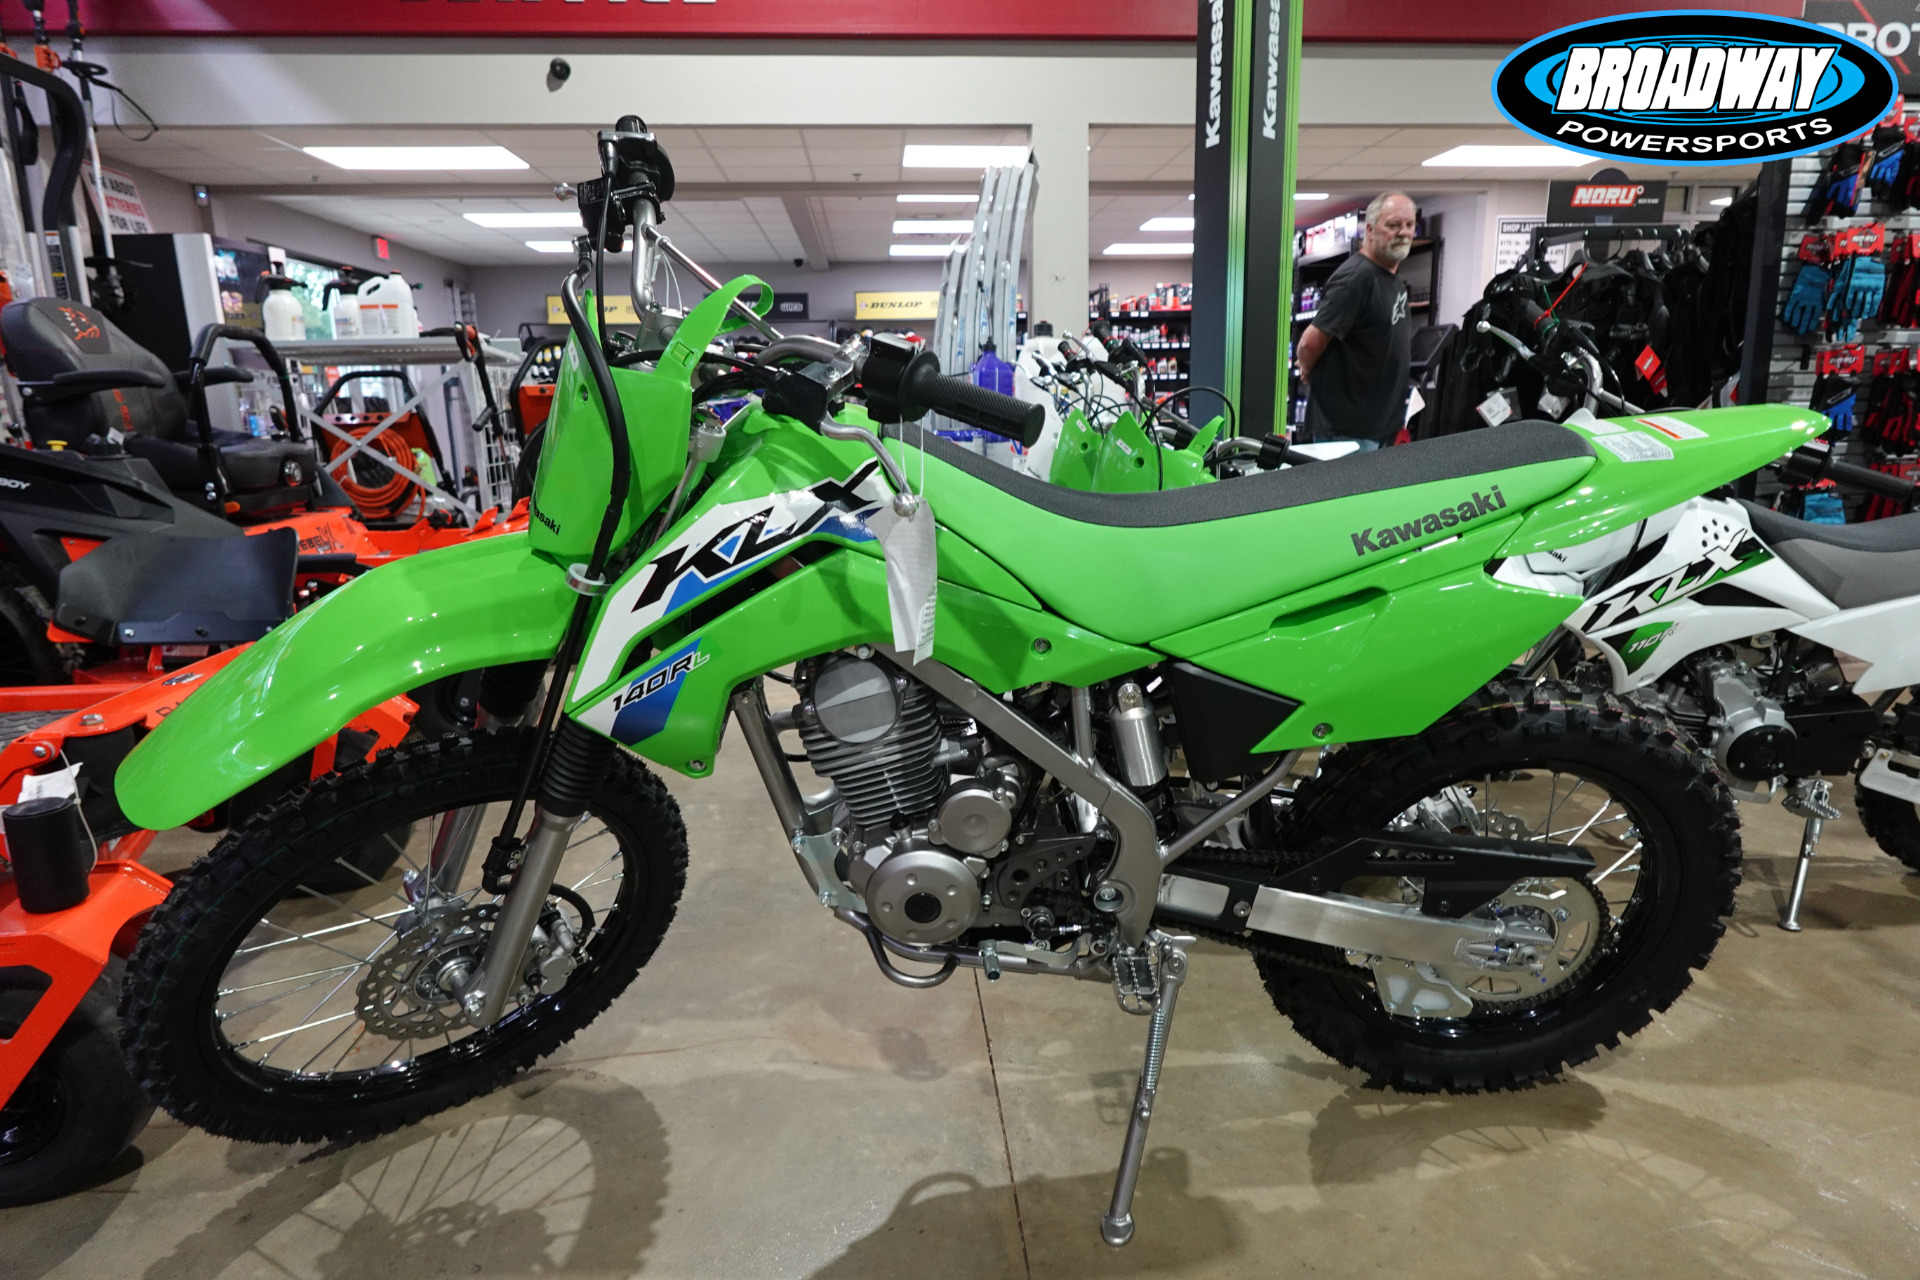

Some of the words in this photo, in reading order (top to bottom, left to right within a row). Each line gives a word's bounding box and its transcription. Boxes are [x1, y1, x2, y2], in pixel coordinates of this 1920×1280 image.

[1205, 0, 1224, 149] Kawasa
[1573, 186, 1638, 205] NORU
[104, 195, 146, 218] ATTERIES
[1502, 223, 1520, 233] SHOP
[870, 301, 923, 309] DUNLOP
[1350, 484, 1508, 558] Kawasaki
